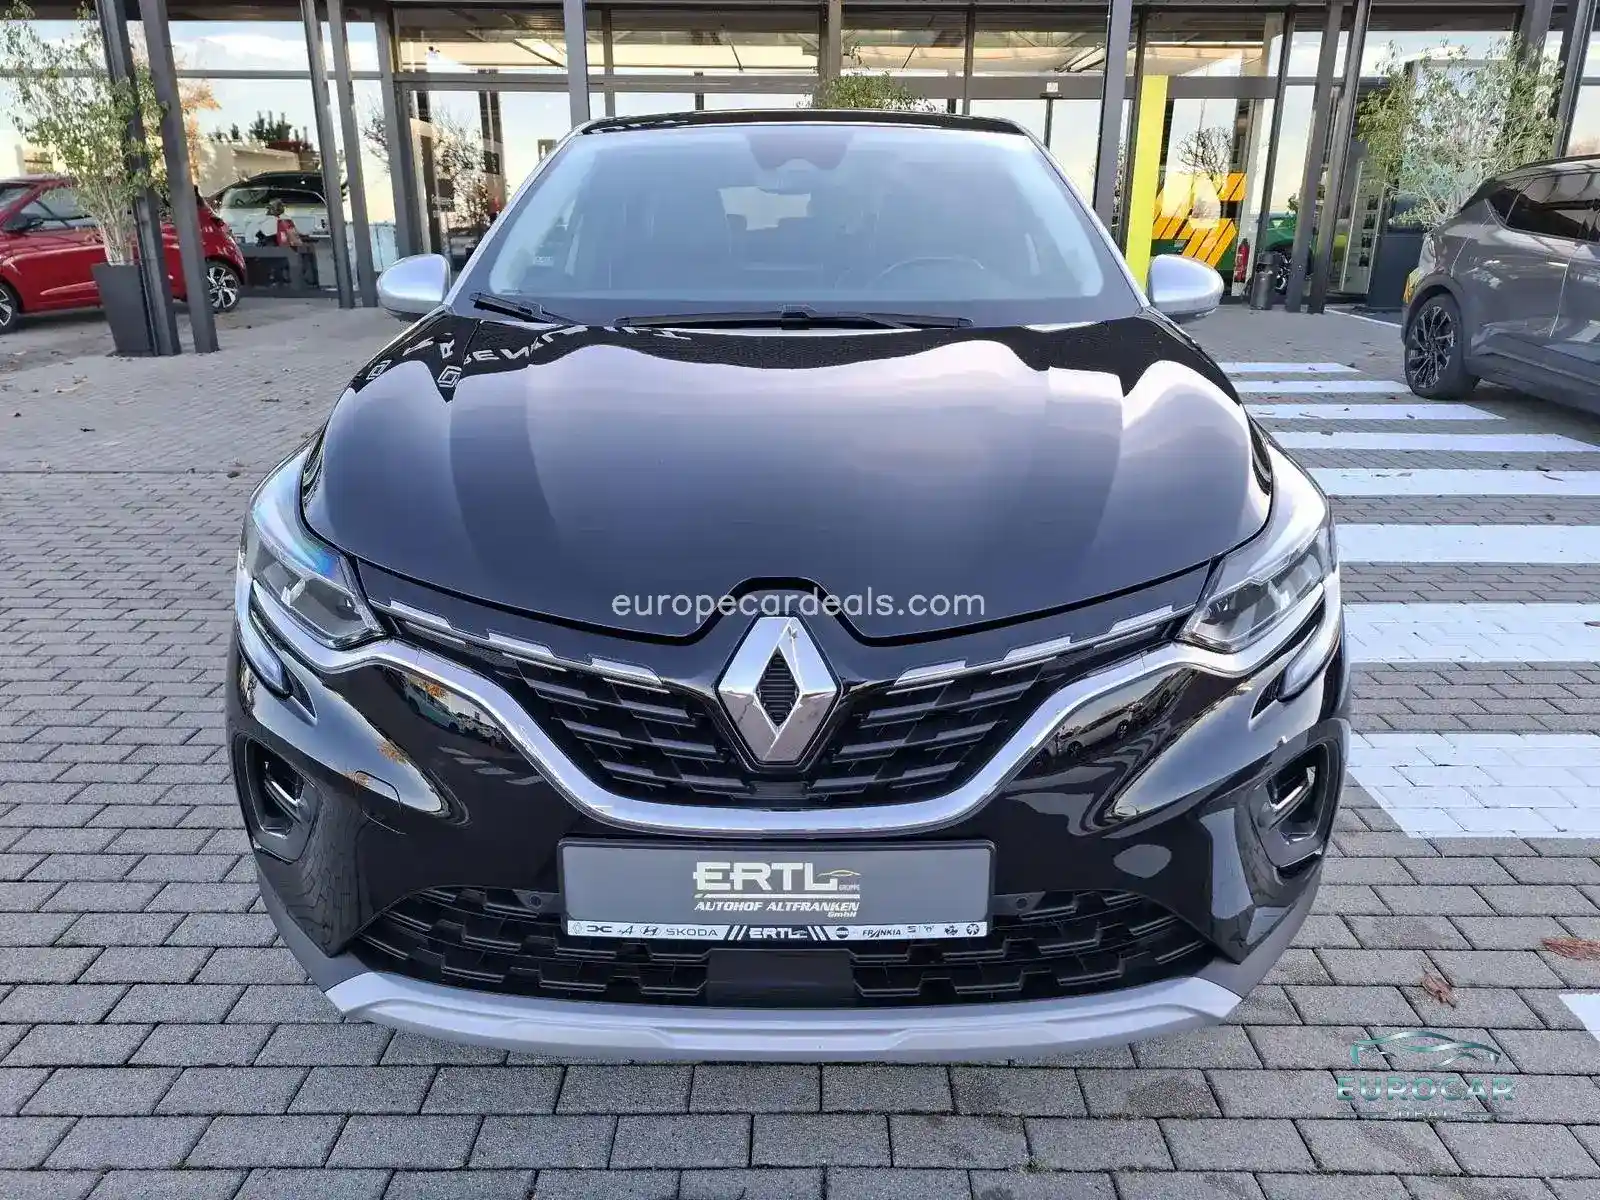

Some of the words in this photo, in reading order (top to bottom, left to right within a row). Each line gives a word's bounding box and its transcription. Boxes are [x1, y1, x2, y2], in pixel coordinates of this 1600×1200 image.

[693, 862, 838, 891] ERTL
[694, 902, 763, 912] AUTOHOF
[767, 902, 860, 912] ALTFRANKEN
[749, 927, 807, 939] ERTL
